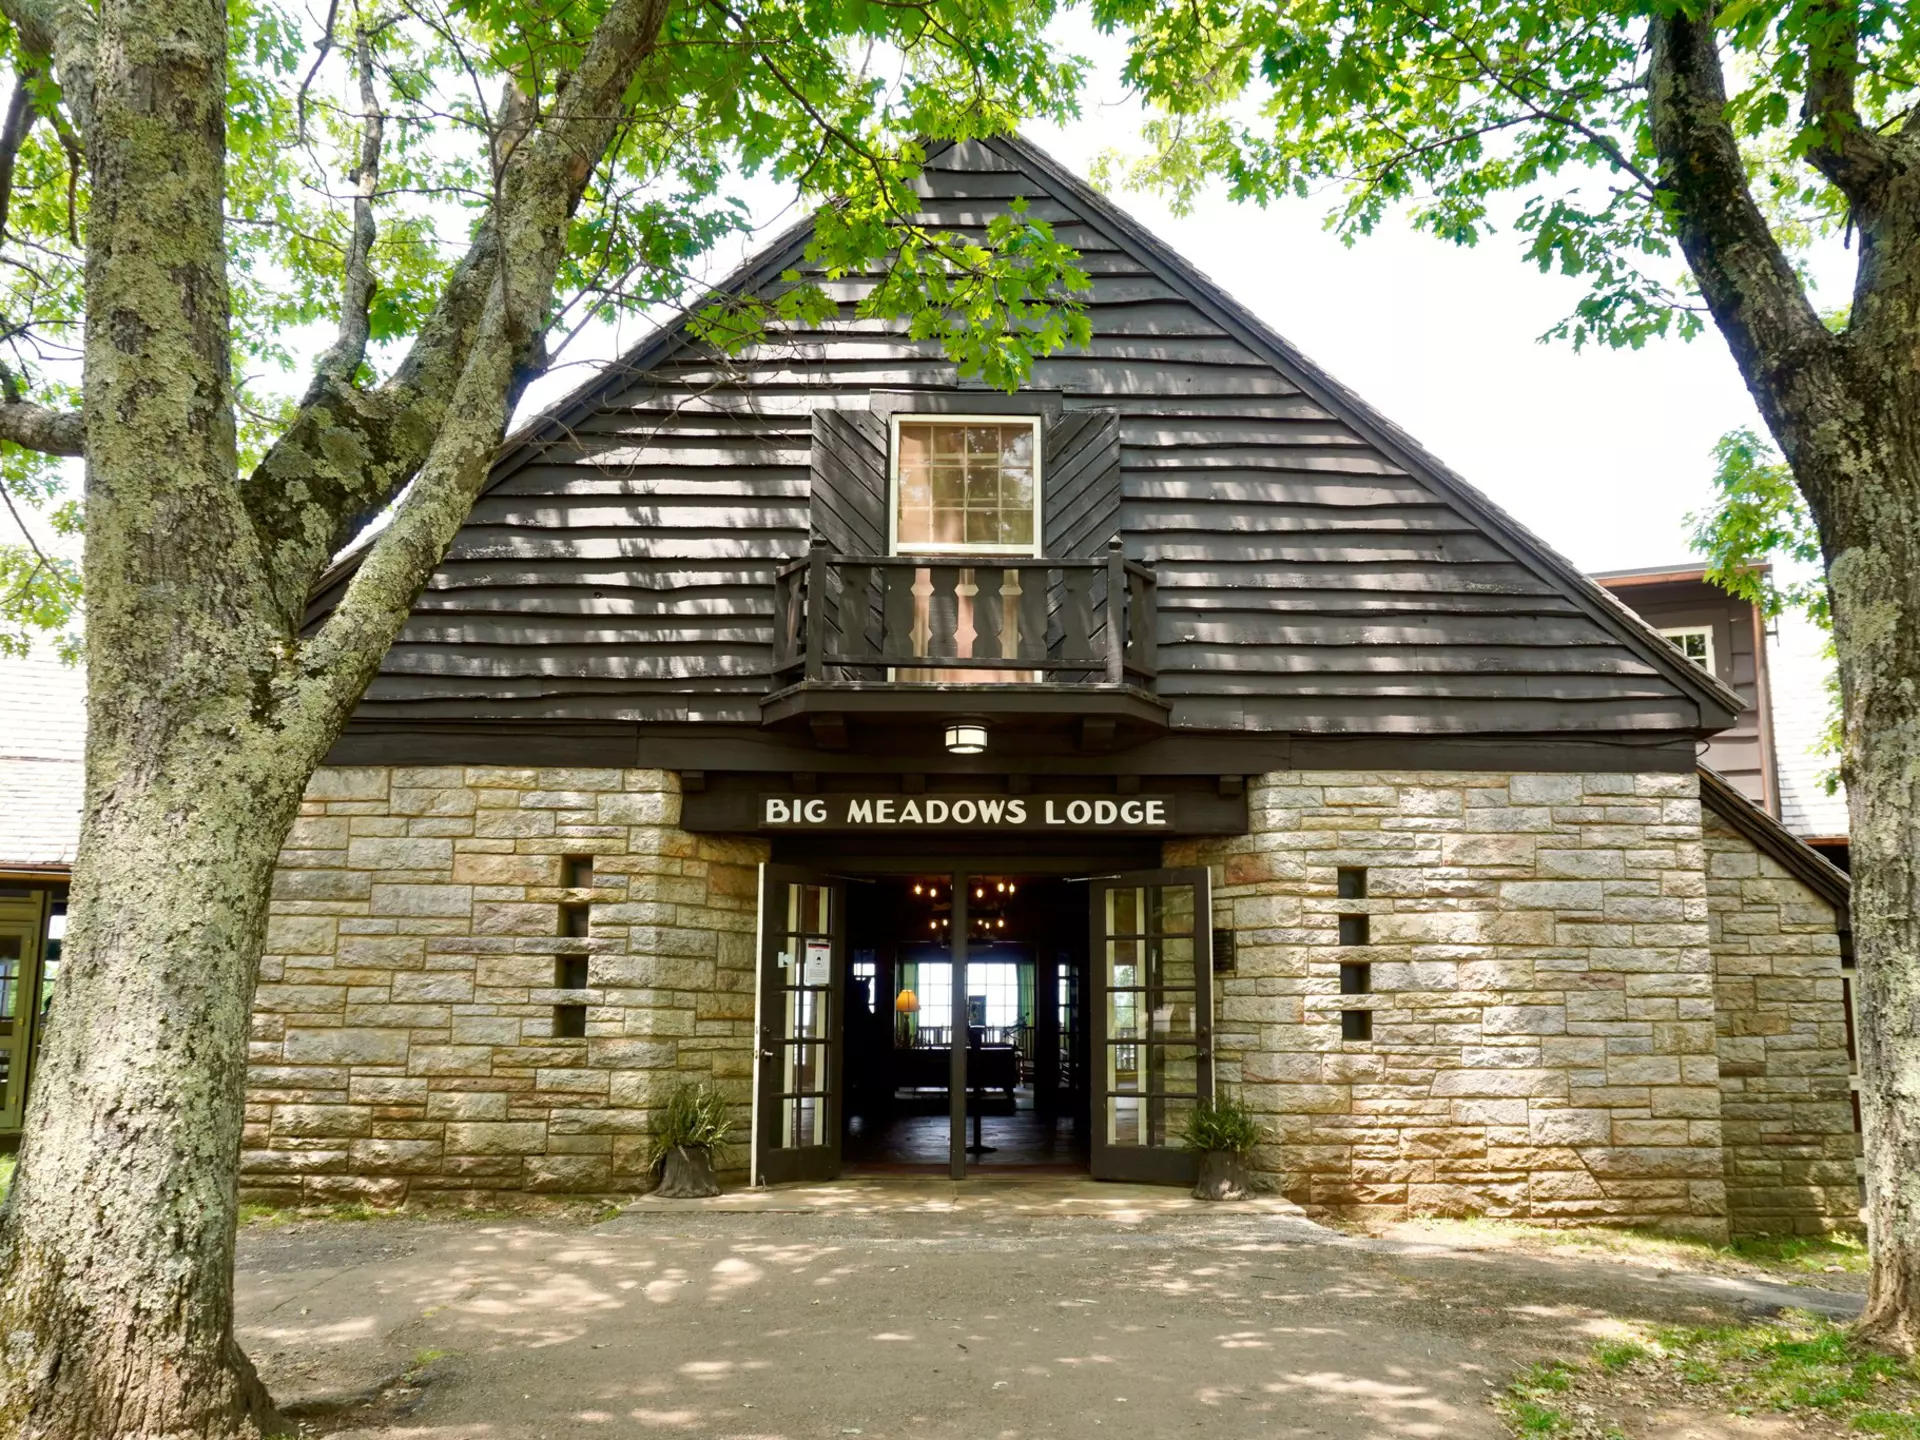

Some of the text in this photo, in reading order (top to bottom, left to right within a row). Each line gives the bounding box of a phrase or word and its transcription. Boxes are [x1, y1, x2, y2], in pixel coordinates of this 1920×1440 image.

[766, 799, 1167, 825] BIG MEADOWS LODGE
